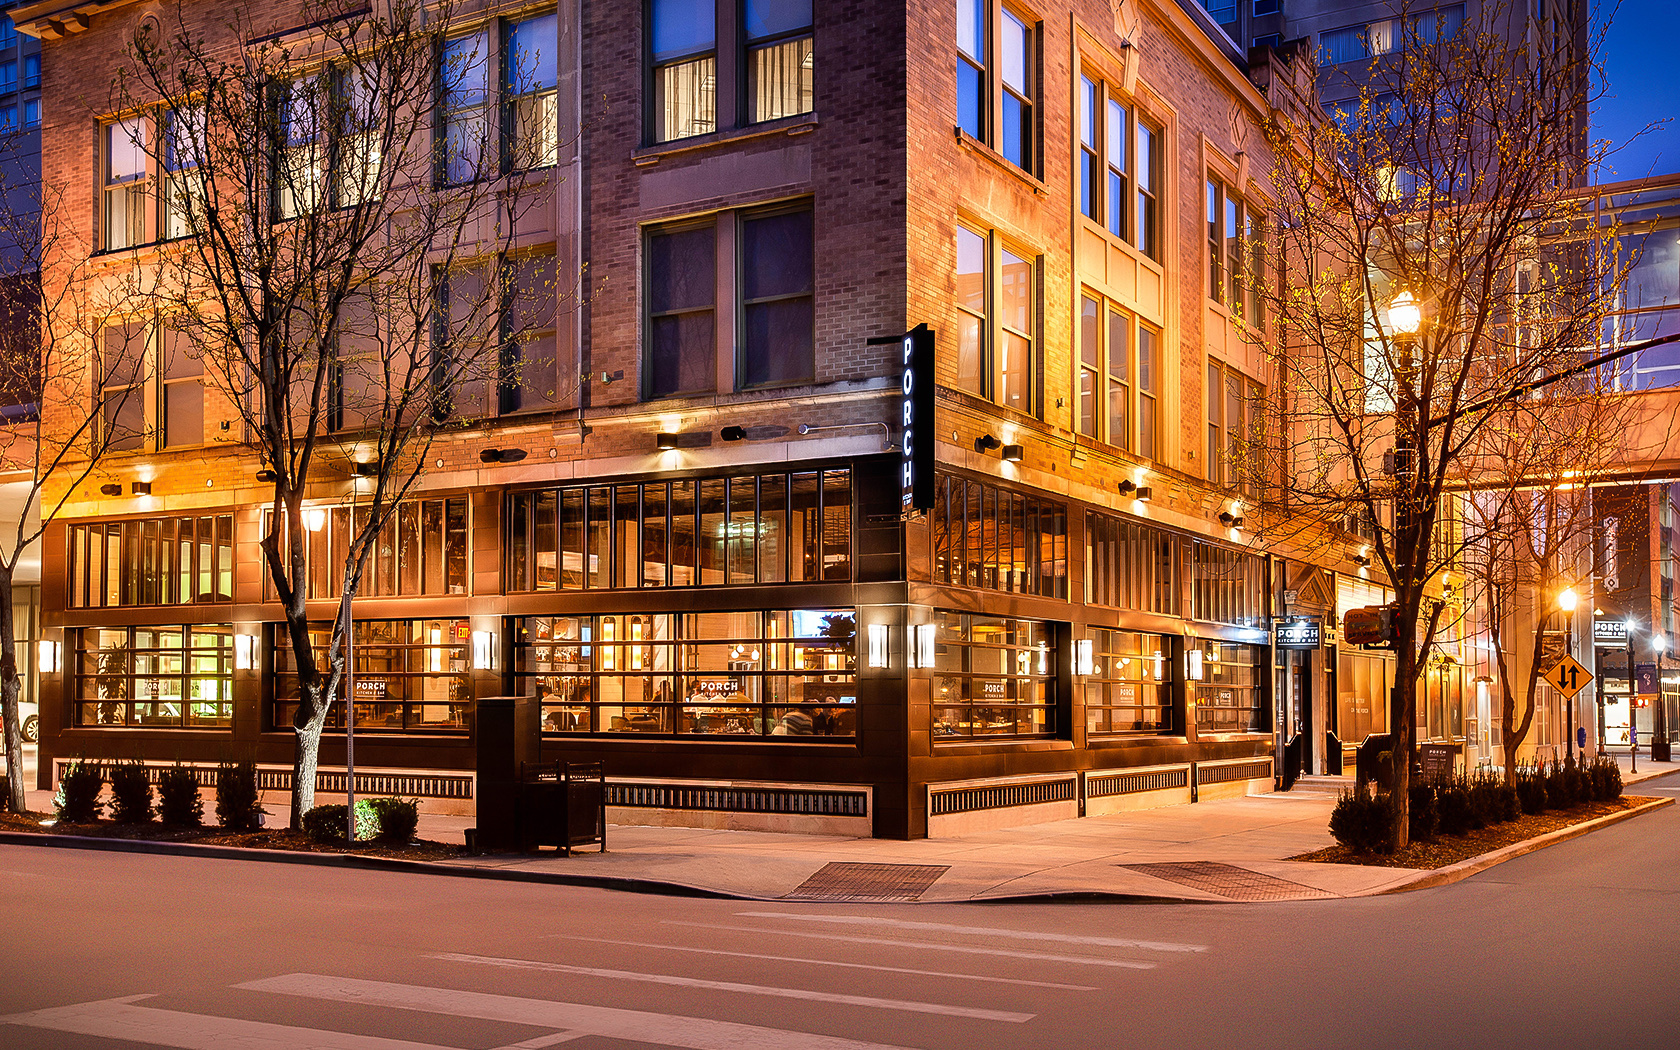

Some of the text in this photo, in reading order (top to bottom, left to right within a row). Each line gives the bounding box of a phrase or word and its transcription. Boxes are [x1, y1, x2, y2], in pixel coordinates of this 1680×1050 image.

[903, 337, 912, 488] PORCH
[1594, 623, 1626, 631] PORCH
[458, 627, 469, 637] EXIT
[1277, 629, 1318, 638] PORCH
[356, 682, 385, 690] PORCH
[701, 682, 738, 691] PORCH
[985, 684, 1004, 692] PORCH
